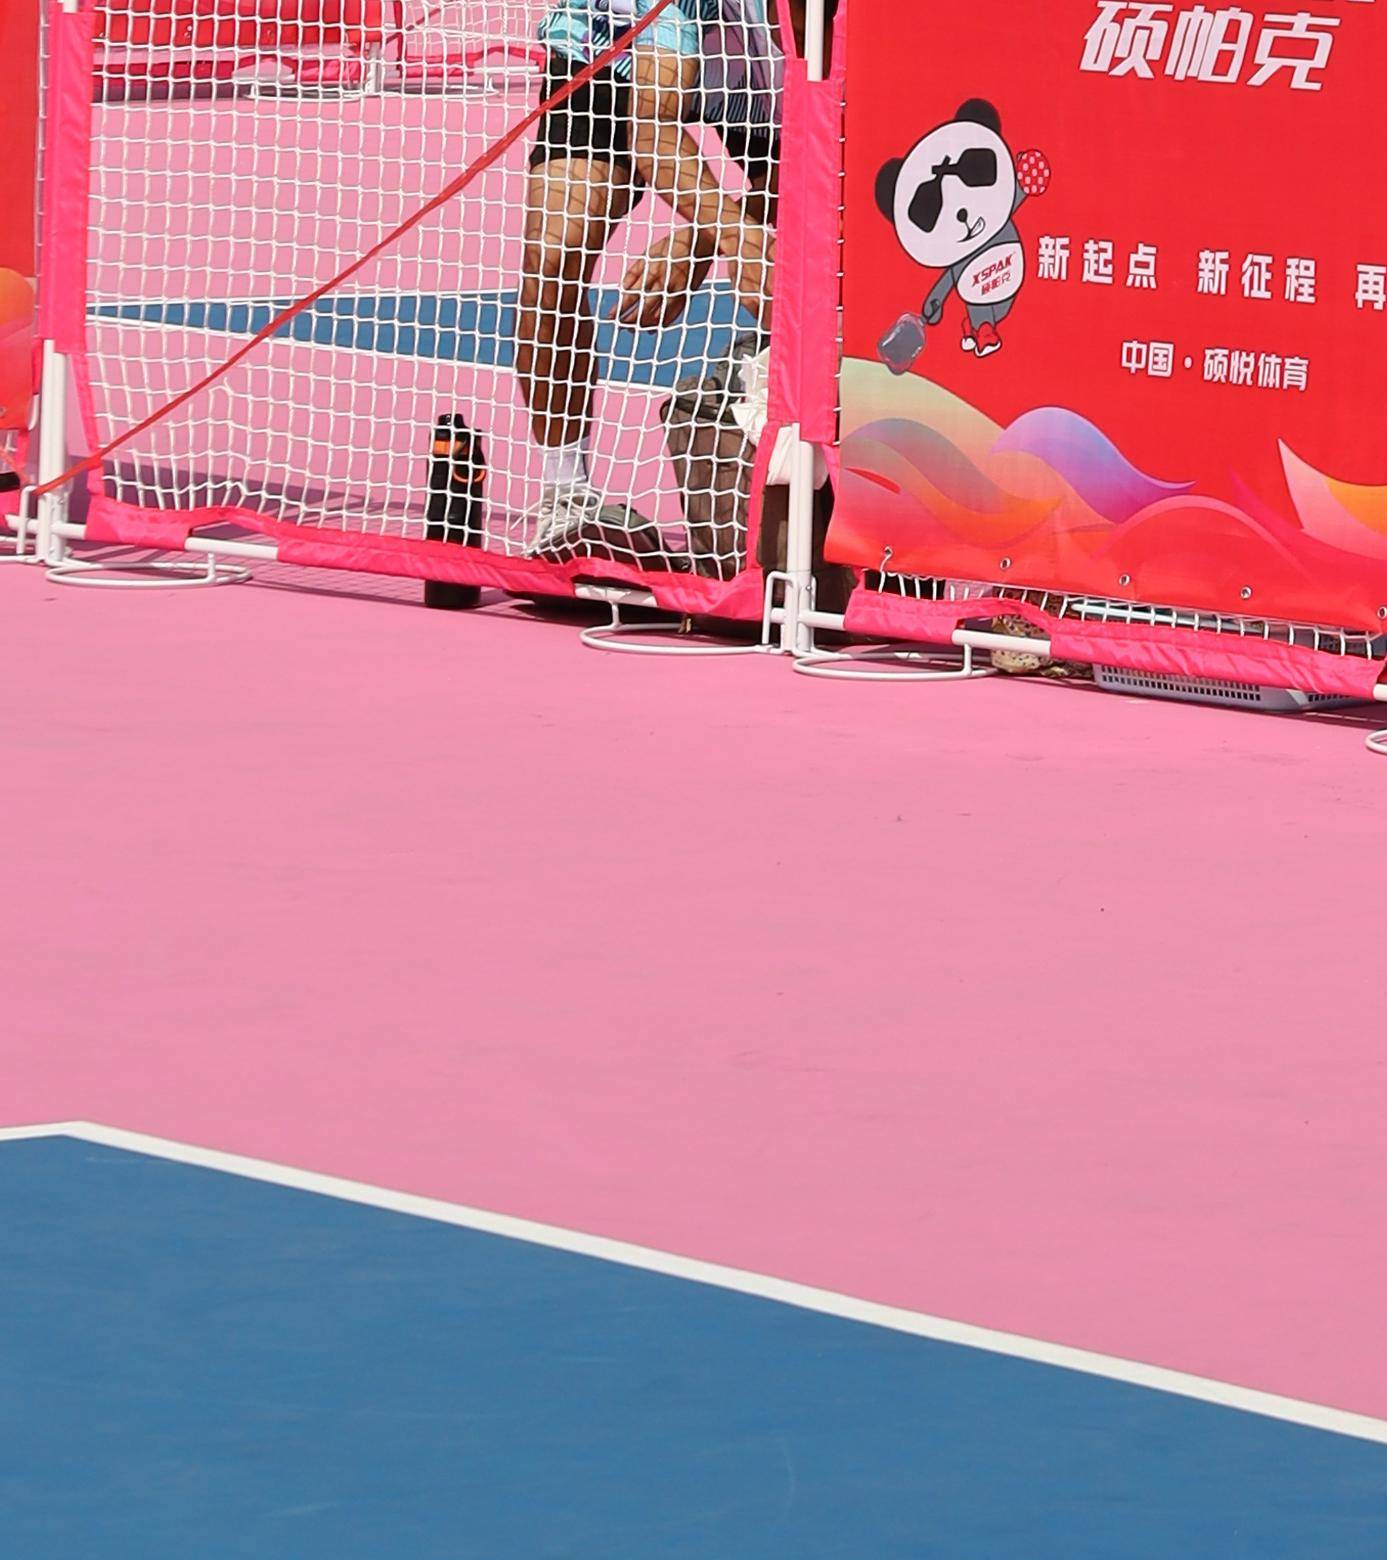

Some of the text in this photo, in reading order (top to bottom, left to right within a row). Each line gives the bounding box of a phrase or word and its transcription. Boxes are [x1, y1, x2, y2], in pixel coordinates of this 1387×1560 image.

[1079, 0, 1342, 92] 硕帕克
[1037, 235, 1158, 290] 新起点
[1196, 249, 1317, 304] 新征程
